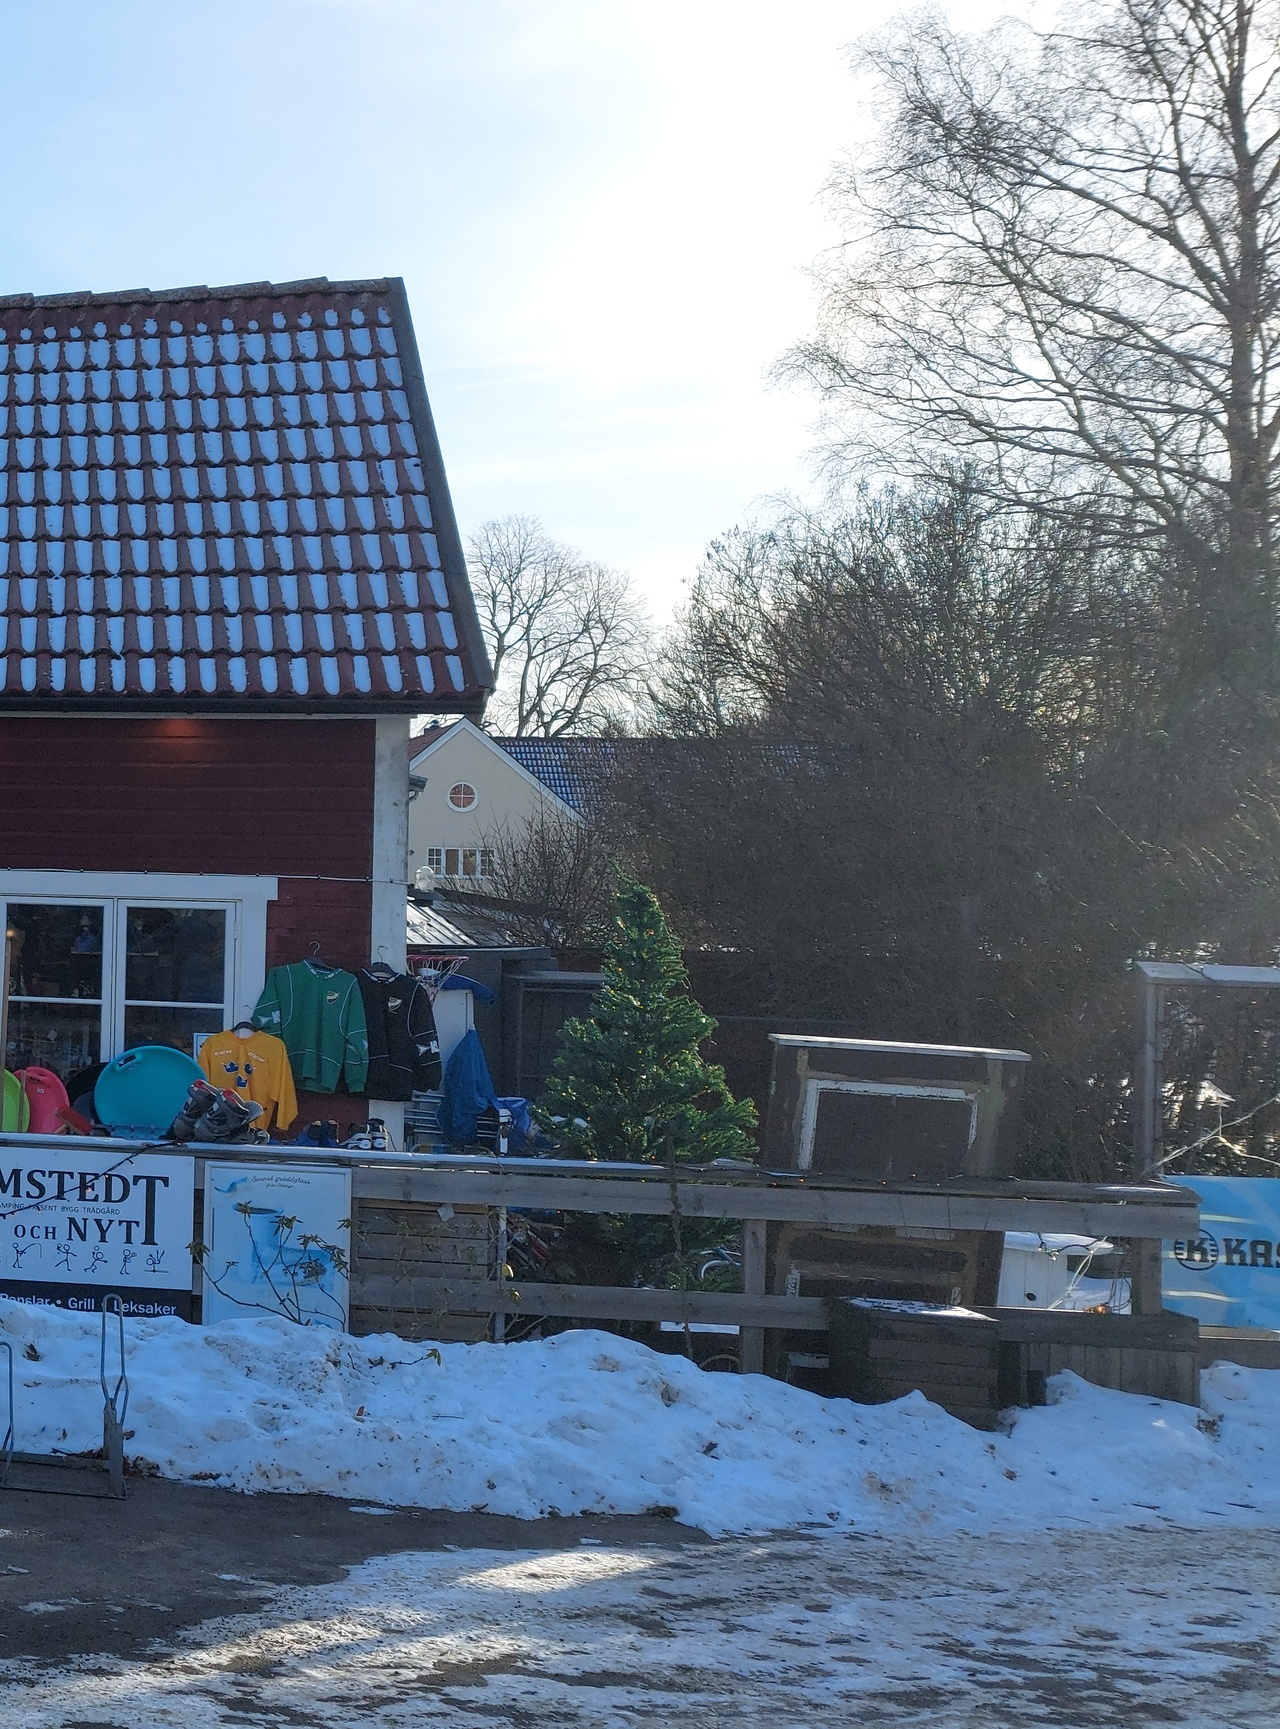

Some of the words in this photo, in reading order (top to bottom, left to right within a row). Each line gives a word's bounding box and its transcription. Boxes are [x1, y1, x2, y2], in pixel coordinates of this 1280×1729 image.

[83, 1206, 121, 1216] TRÄDGÅRD
[13, 1223, 57, 1240] OCH
[1222, 1238, 1280, 1269] KA
[68, 1297, 95, 1310] Grill
[113, 1300, 177, 1315] Leksaker
